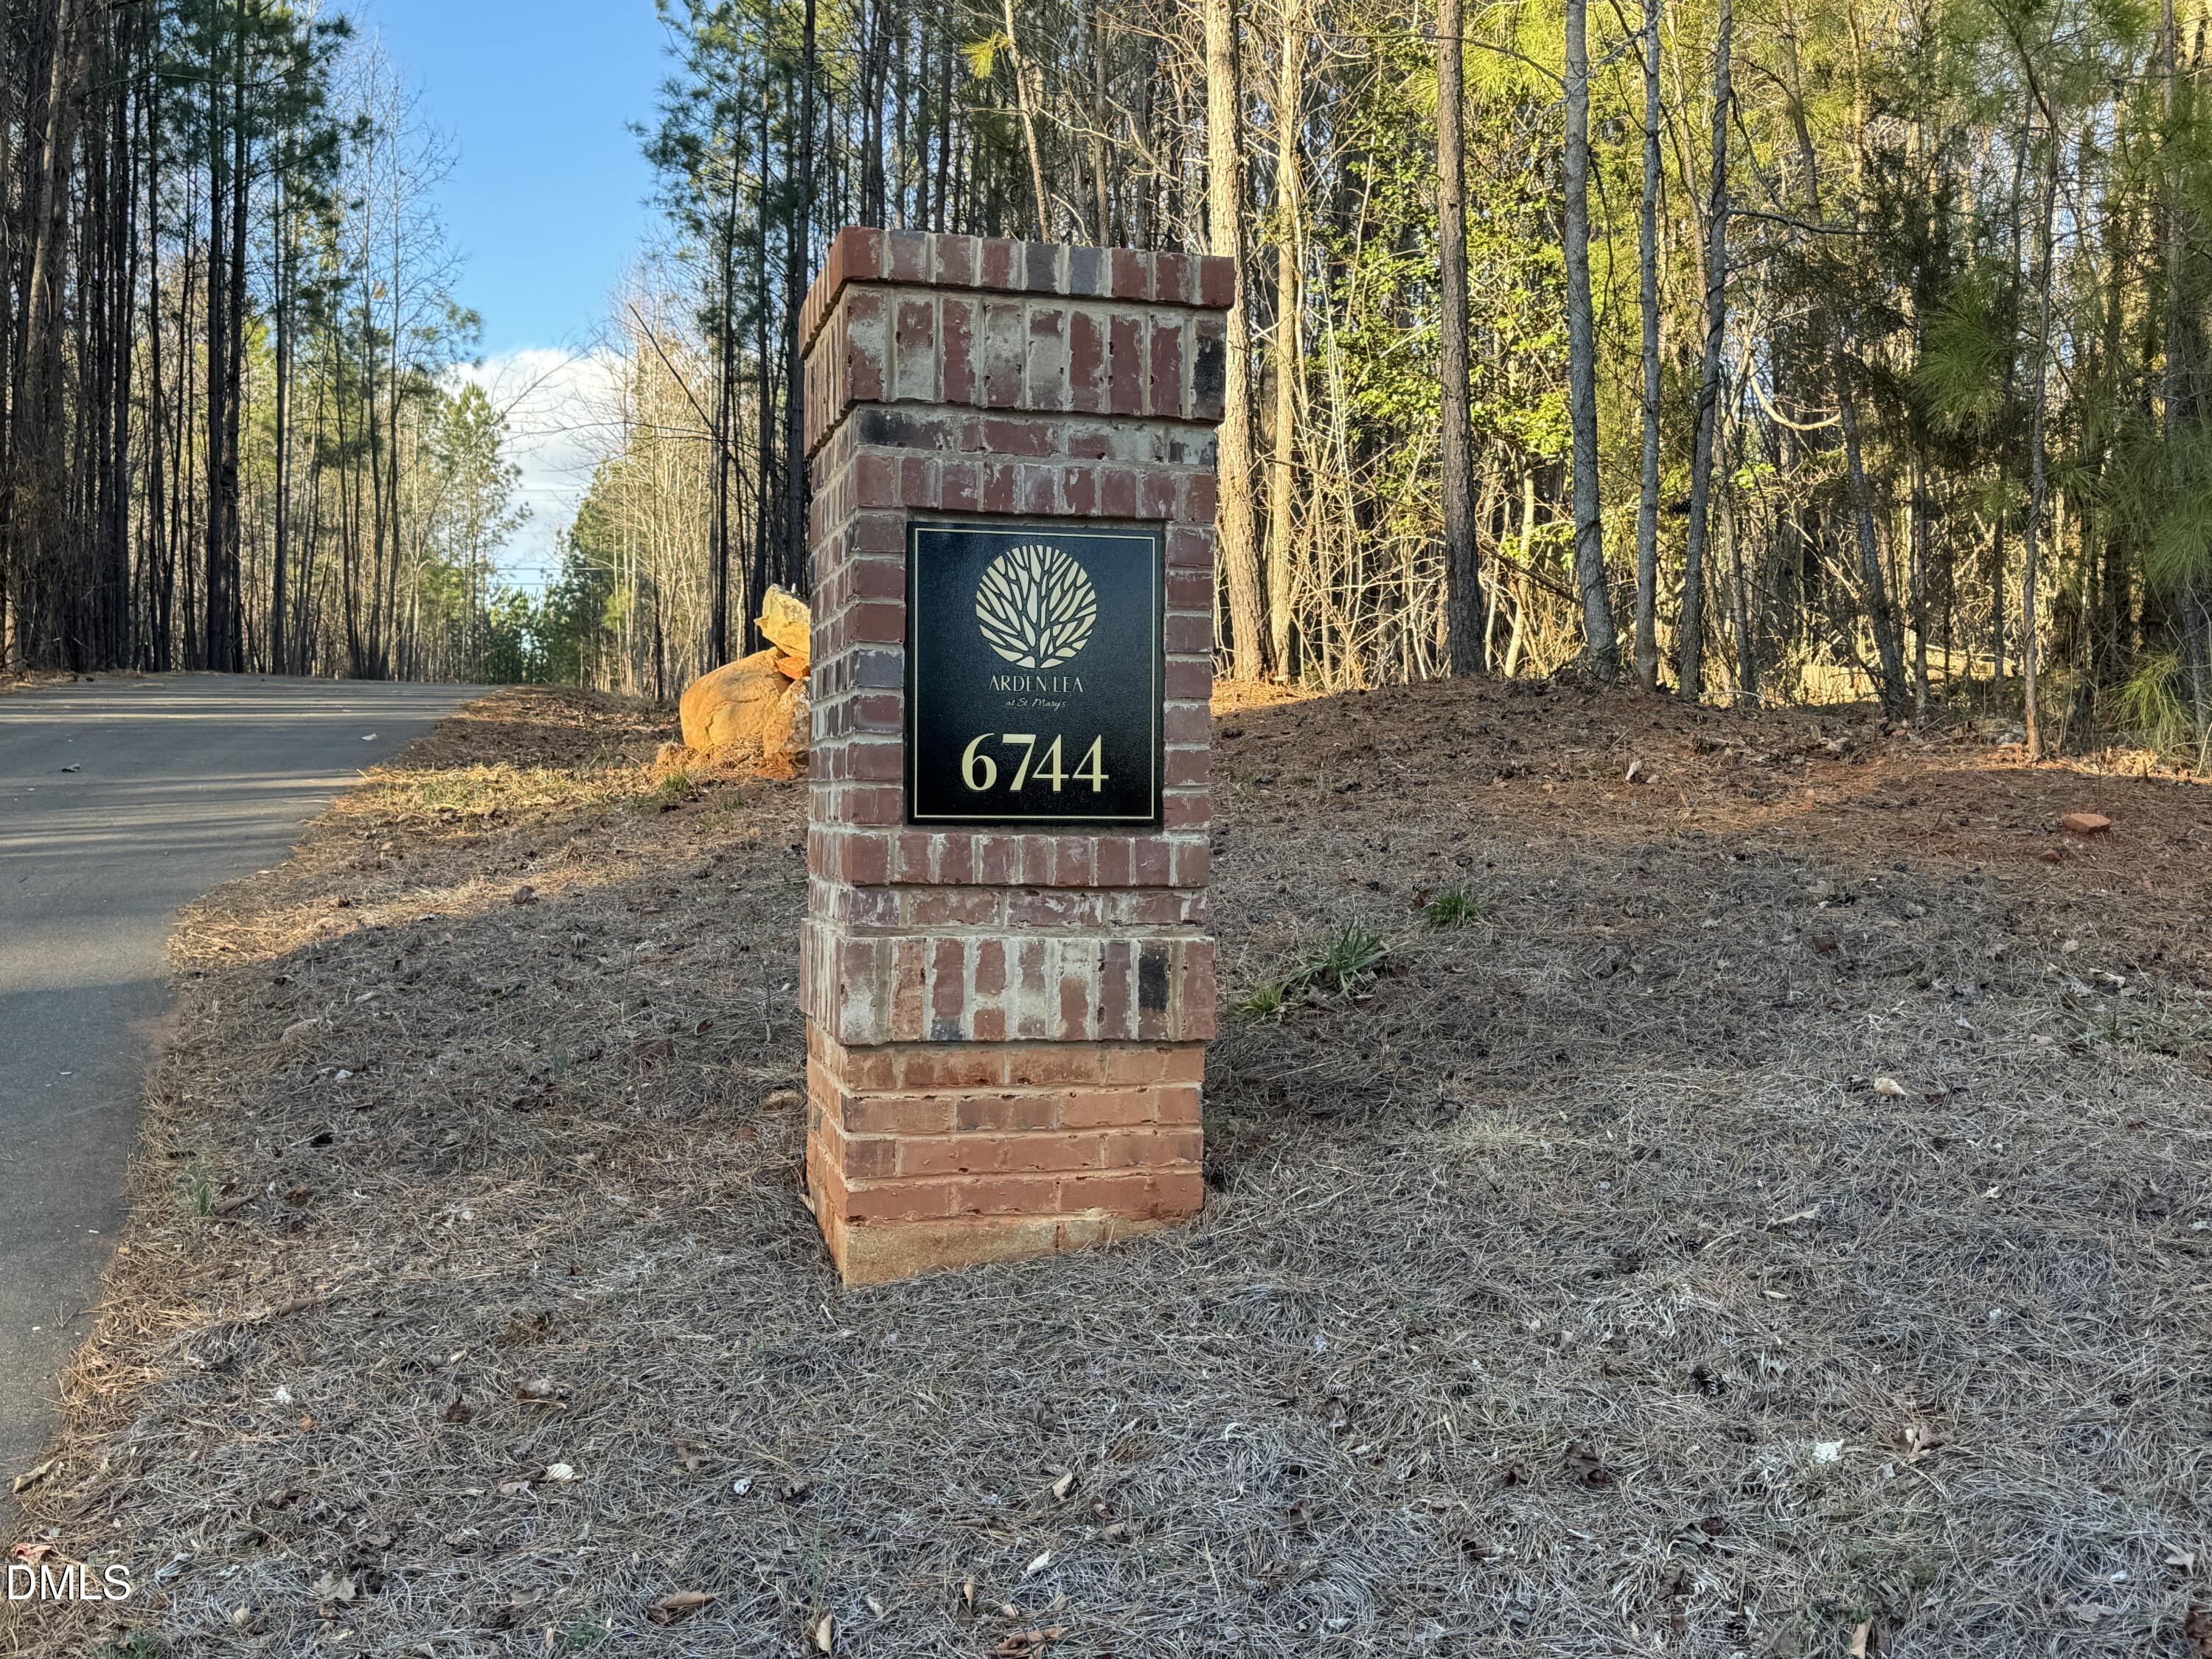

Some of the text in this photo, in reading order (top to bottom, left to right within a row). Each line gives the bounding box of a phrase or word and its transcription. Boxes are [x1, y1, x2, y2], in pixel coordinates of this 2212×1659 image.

[989, 675, 1083, 692] ARDEN LEA
[1031, 698, 1067, 712] Mary's
[961, 732, 1109, 792] 6744
